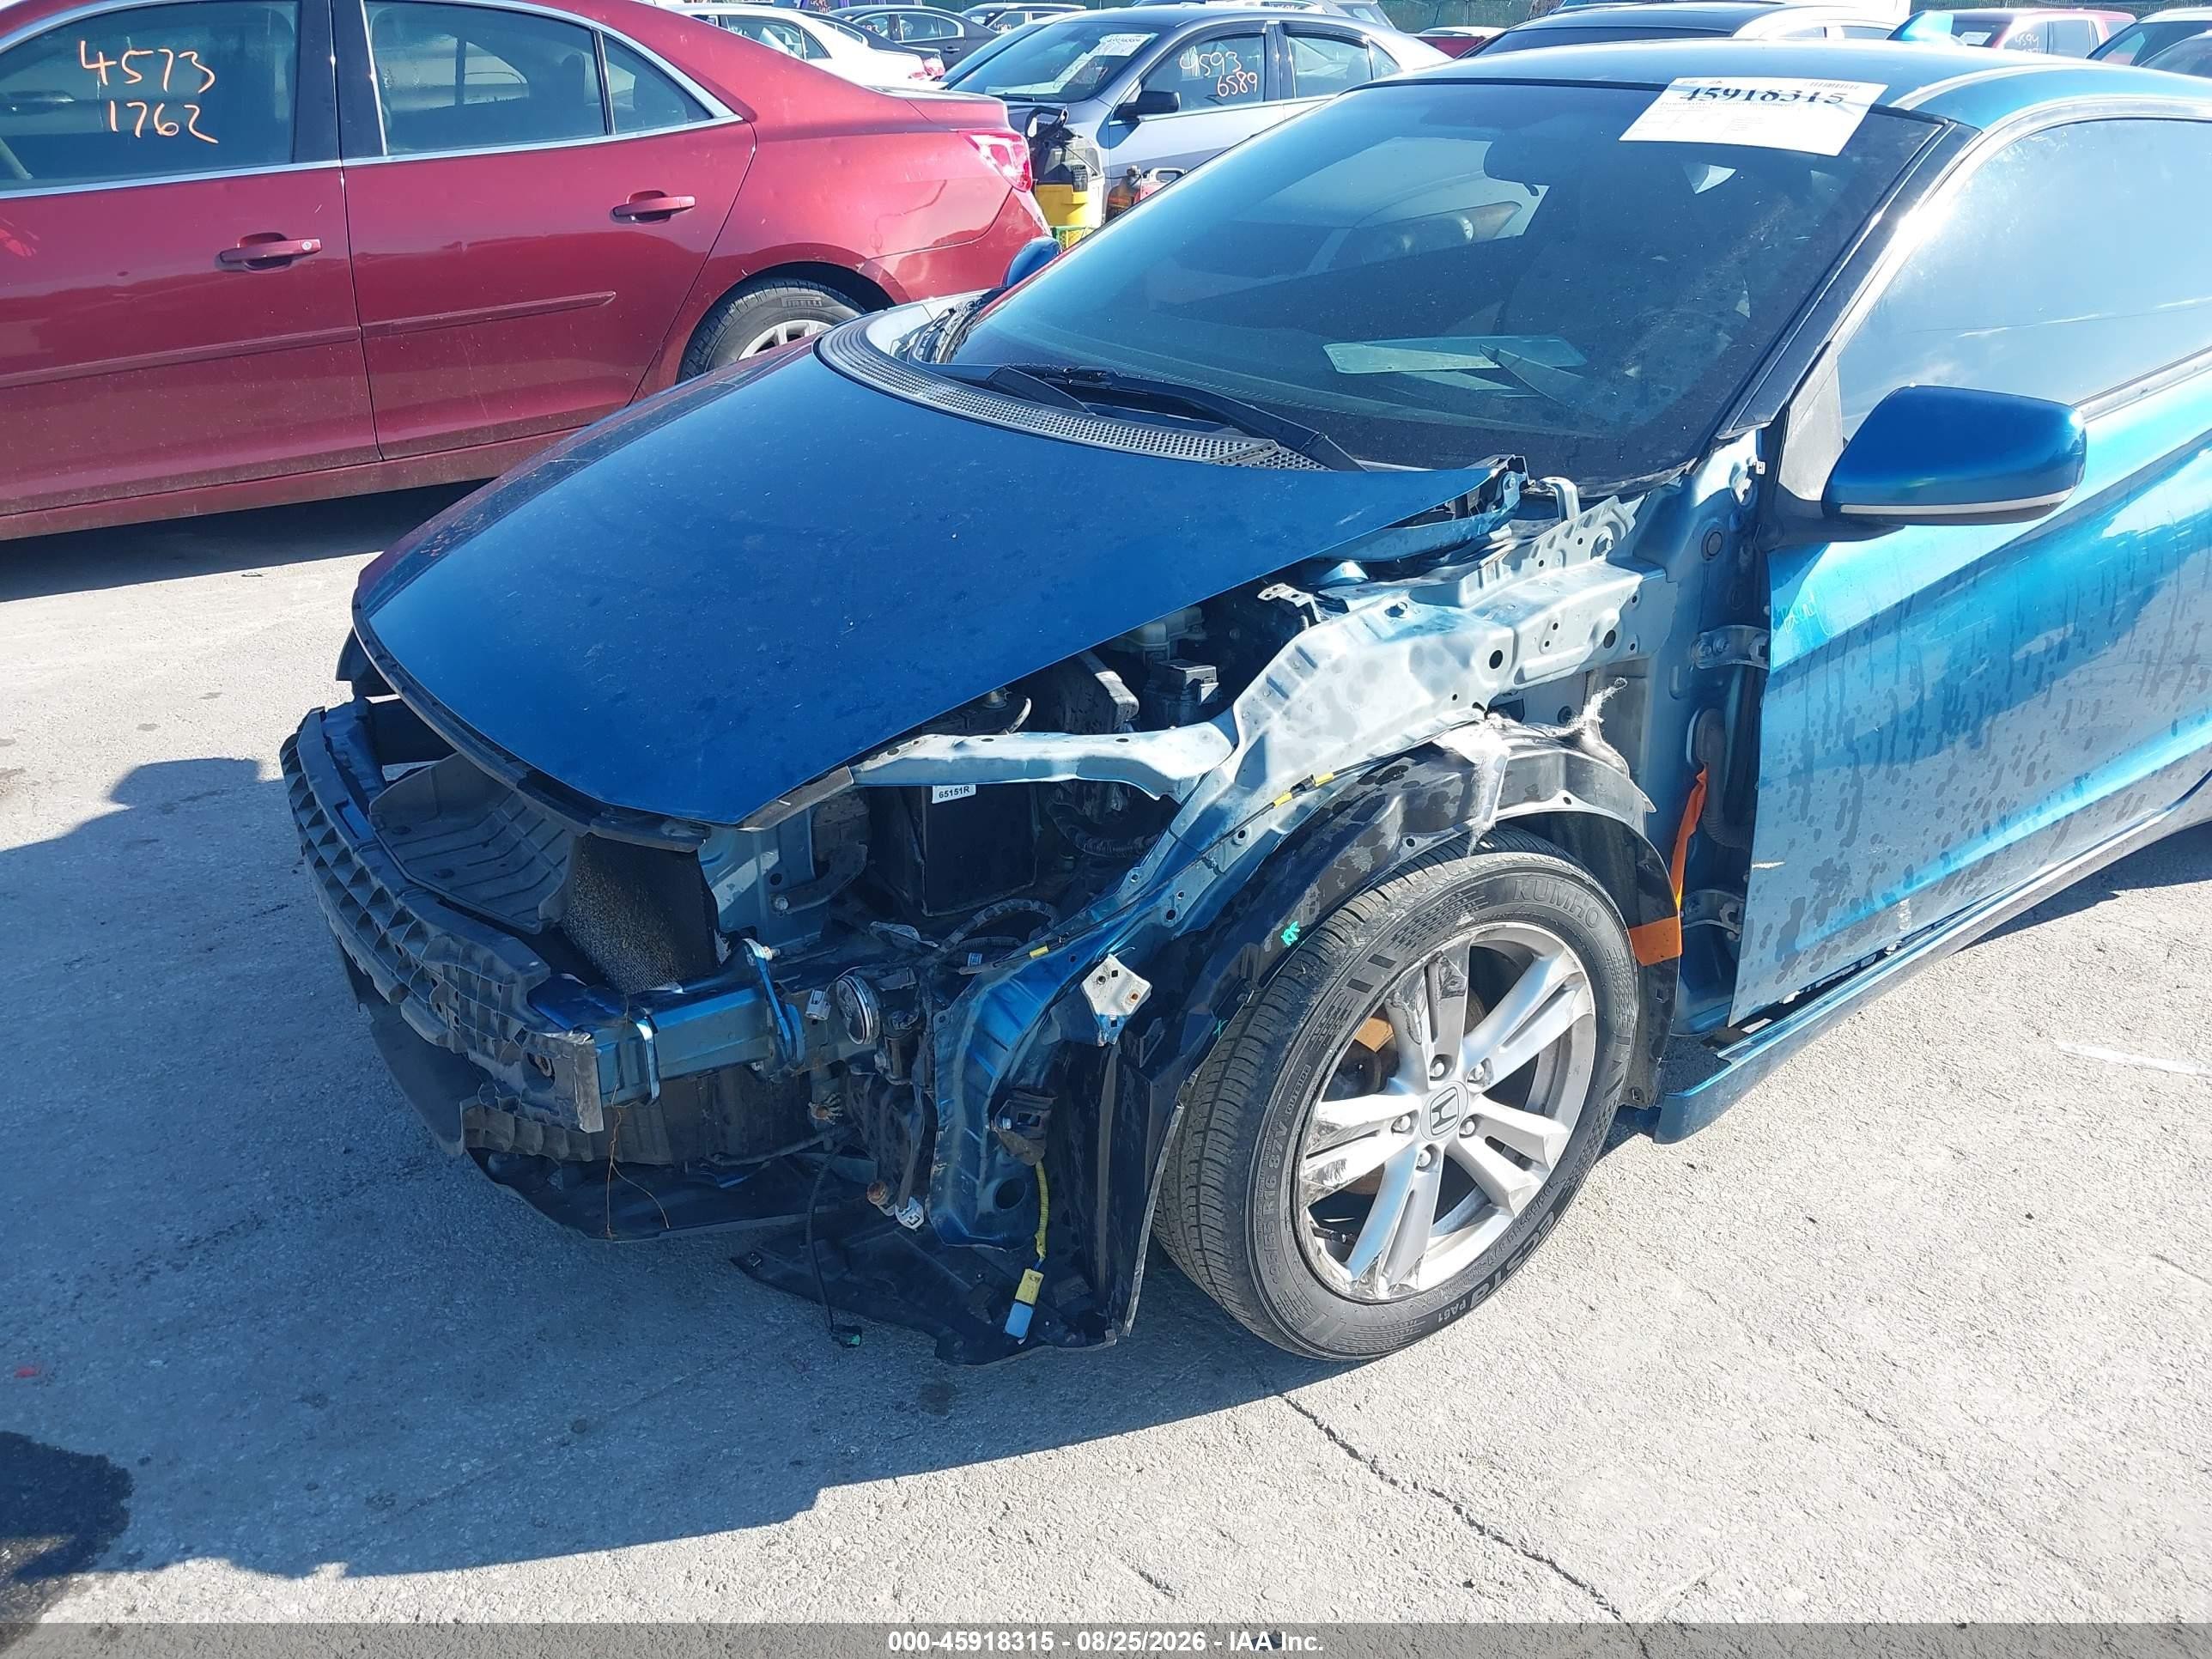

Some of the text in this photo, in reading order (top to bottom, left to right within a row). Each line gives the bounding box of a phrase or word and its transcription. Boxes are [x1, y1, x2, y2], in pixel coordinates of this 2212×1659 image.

[80, 40, 216, 94] 4573
[1179, 51, 1242, 76] 4593
[1217, 70, 1258, 97] 6589
[1679, 86, 1848, 104] 45918315
[109, 100, 219, 144] 1762
[939, 785, 969, 798] 65151R
[1512, 878, 1600, 929] KUMHO
[1287, 1064, 1312, 1115] OUTSIDE
[1437, 1299, 1467, 1322] PA61
